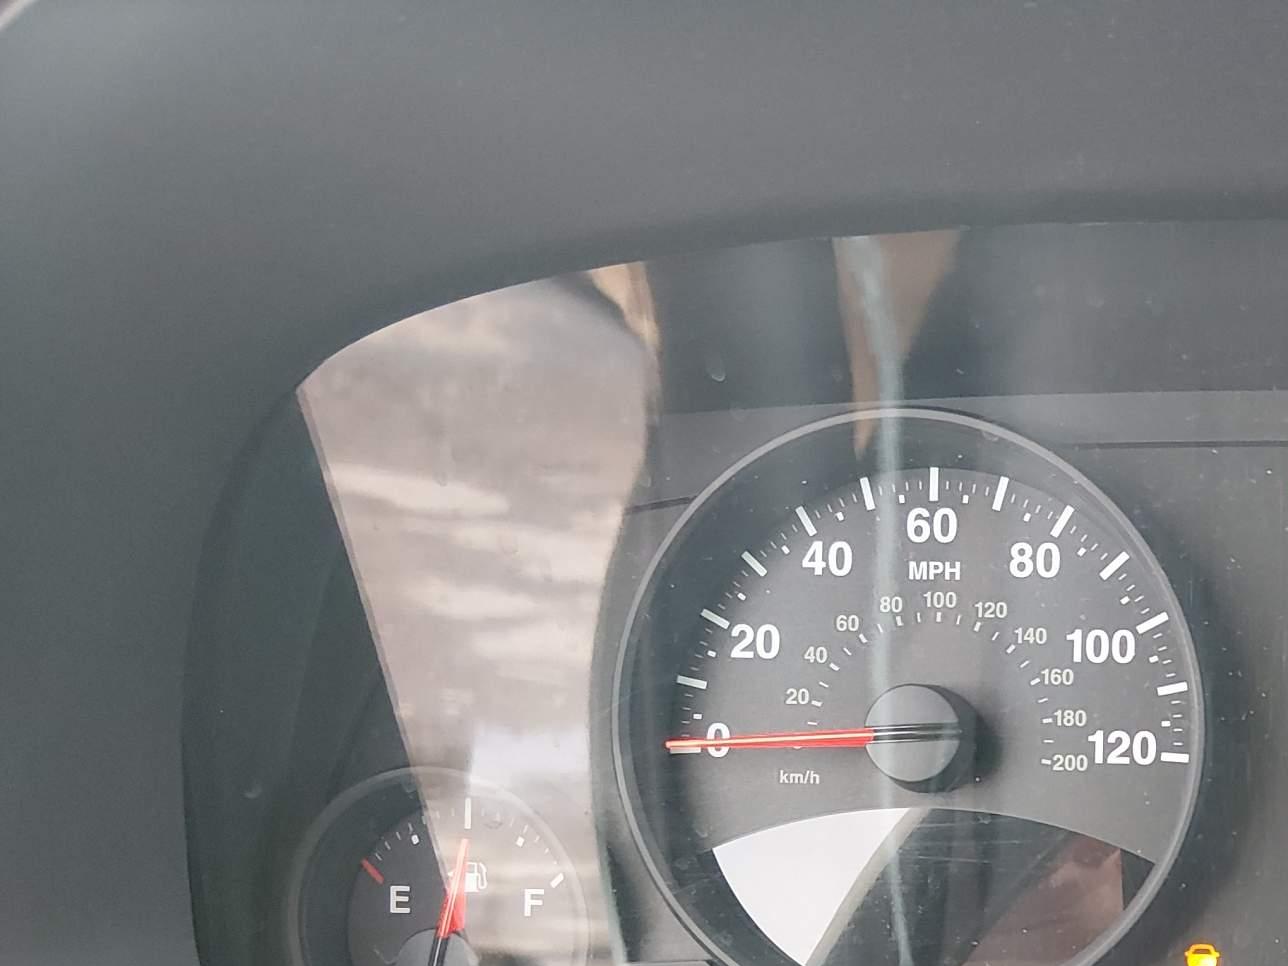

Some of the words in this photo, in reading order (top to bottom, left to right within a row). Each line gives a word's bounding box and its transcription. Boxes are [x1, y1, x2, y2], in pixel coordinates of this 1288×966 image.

[907, 508, 957, 543] 60
[802, 542, 852, 576] 40
[1009, 543, 1061, 578] 80
[908, 561, 961, 580] MPH
[879, 596, 902, 613] 80
[924, 591, 957, 608] 100
[975, 602, 1008, 619] 120
[836, 615, 859, 632] 60
[731, 624, 780, 659] 20
[1014, 628, 1047, 644] 140
[1065, 629, 1135, 663] 100
[804, 647, 827, 664] 40
[1041, 669, 1073, 686] 160
[786, 688, 809, 705] 20
[1054, 710, 1087, 726] 180
[707, 723, 730, 758] 0
[1088, 730, 1157, 765] 120
[1053, 755, 1087, 772] 200
[779, 769, 820, 785] km/h
[390, 886, 410, 913] E
[524, 888, 544, 917] F
